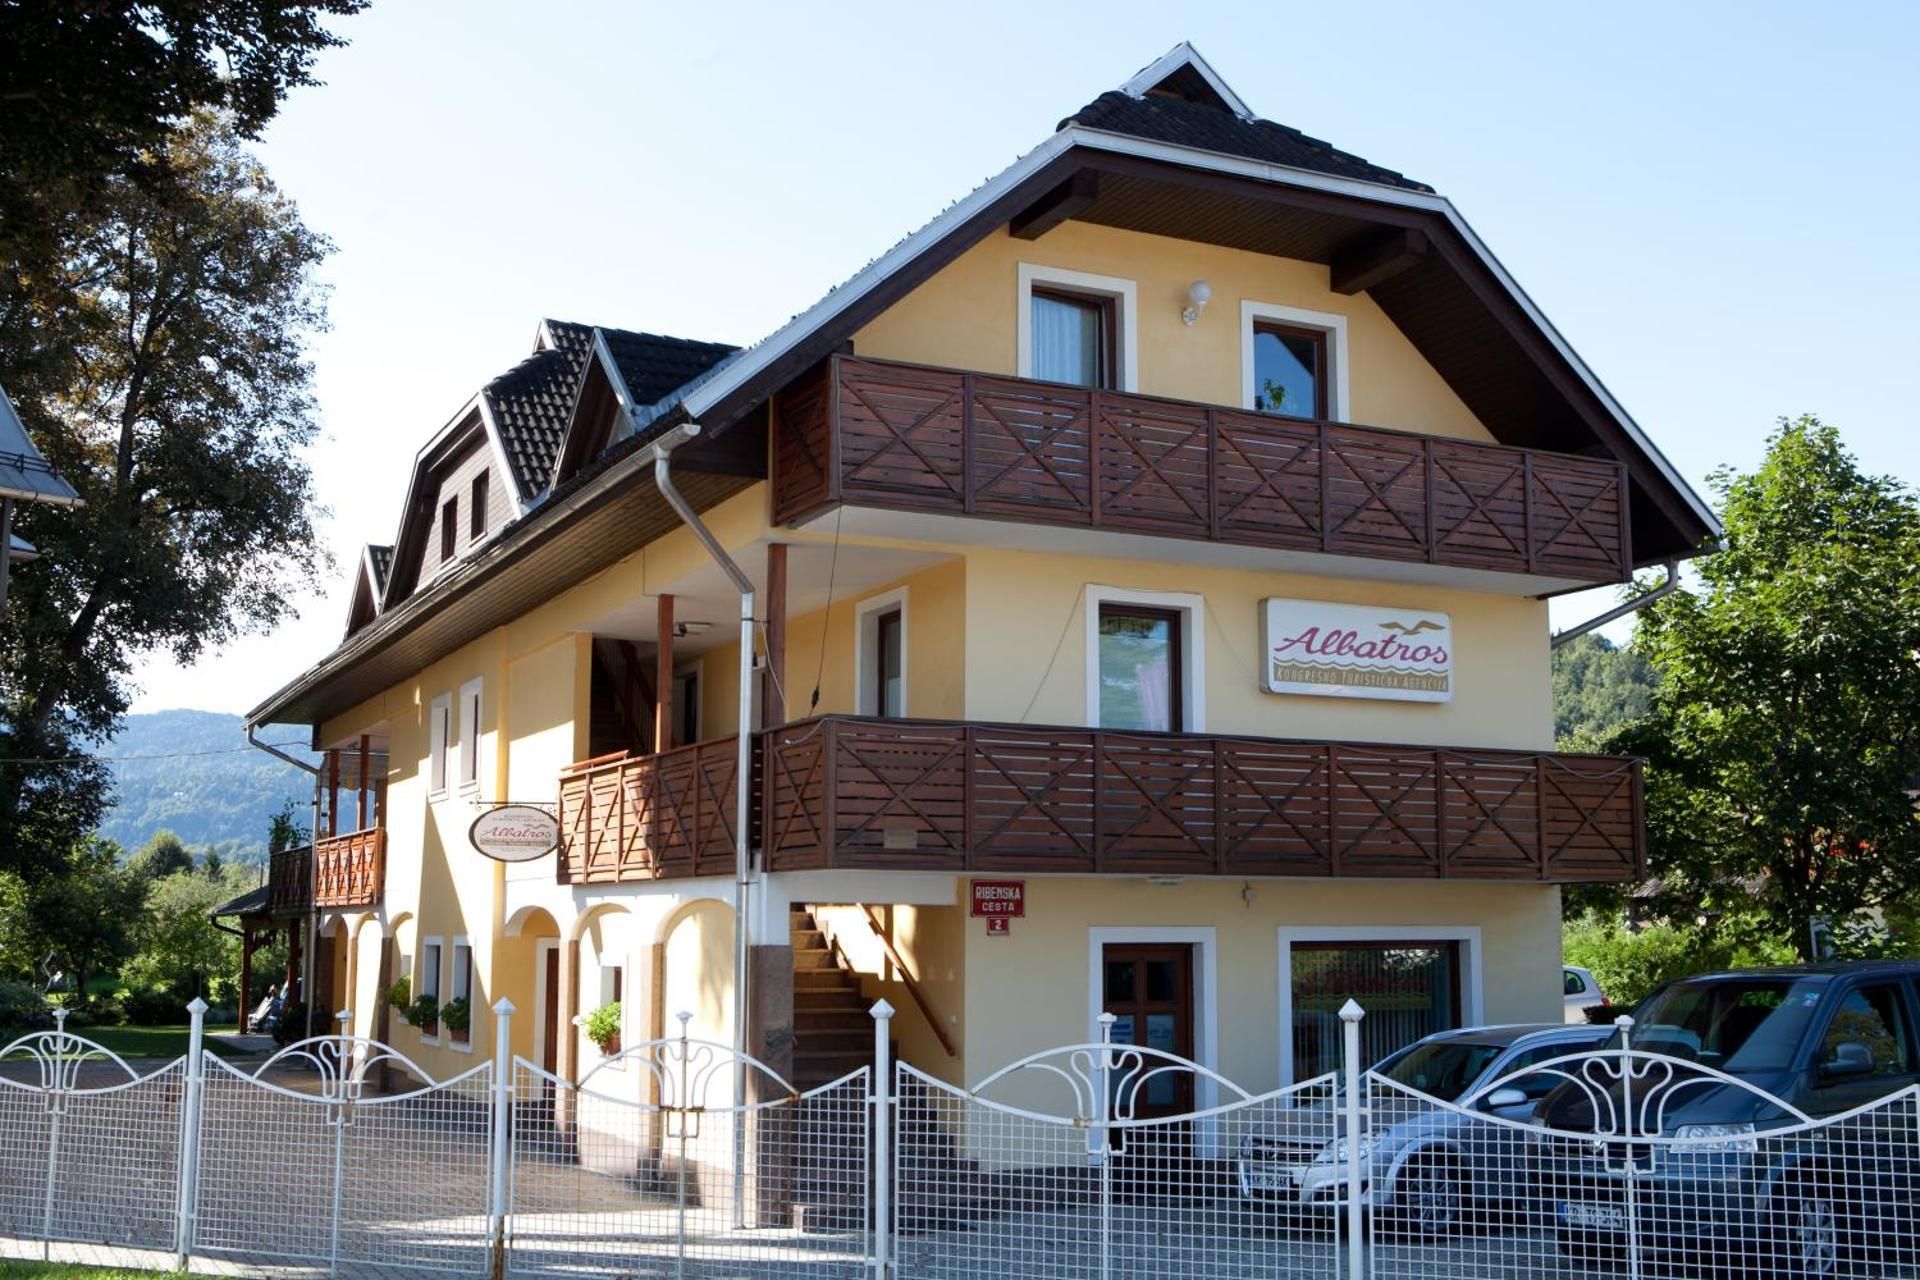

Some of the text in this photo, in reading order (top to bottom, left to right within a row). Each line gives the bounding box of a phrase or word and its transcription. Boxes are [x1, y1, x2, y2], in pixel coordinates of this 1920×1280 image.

[1273, 627, 1448, 664] Albatros
[1276, 666, 1336, 684] KONGRESNO
[480, 826, 552, 838] Albatros
[975, 886, 1021, 900] RIBENSKA
[982, 902, 1015, 912] CESTA
[994, 919, 1002, 930] 2
